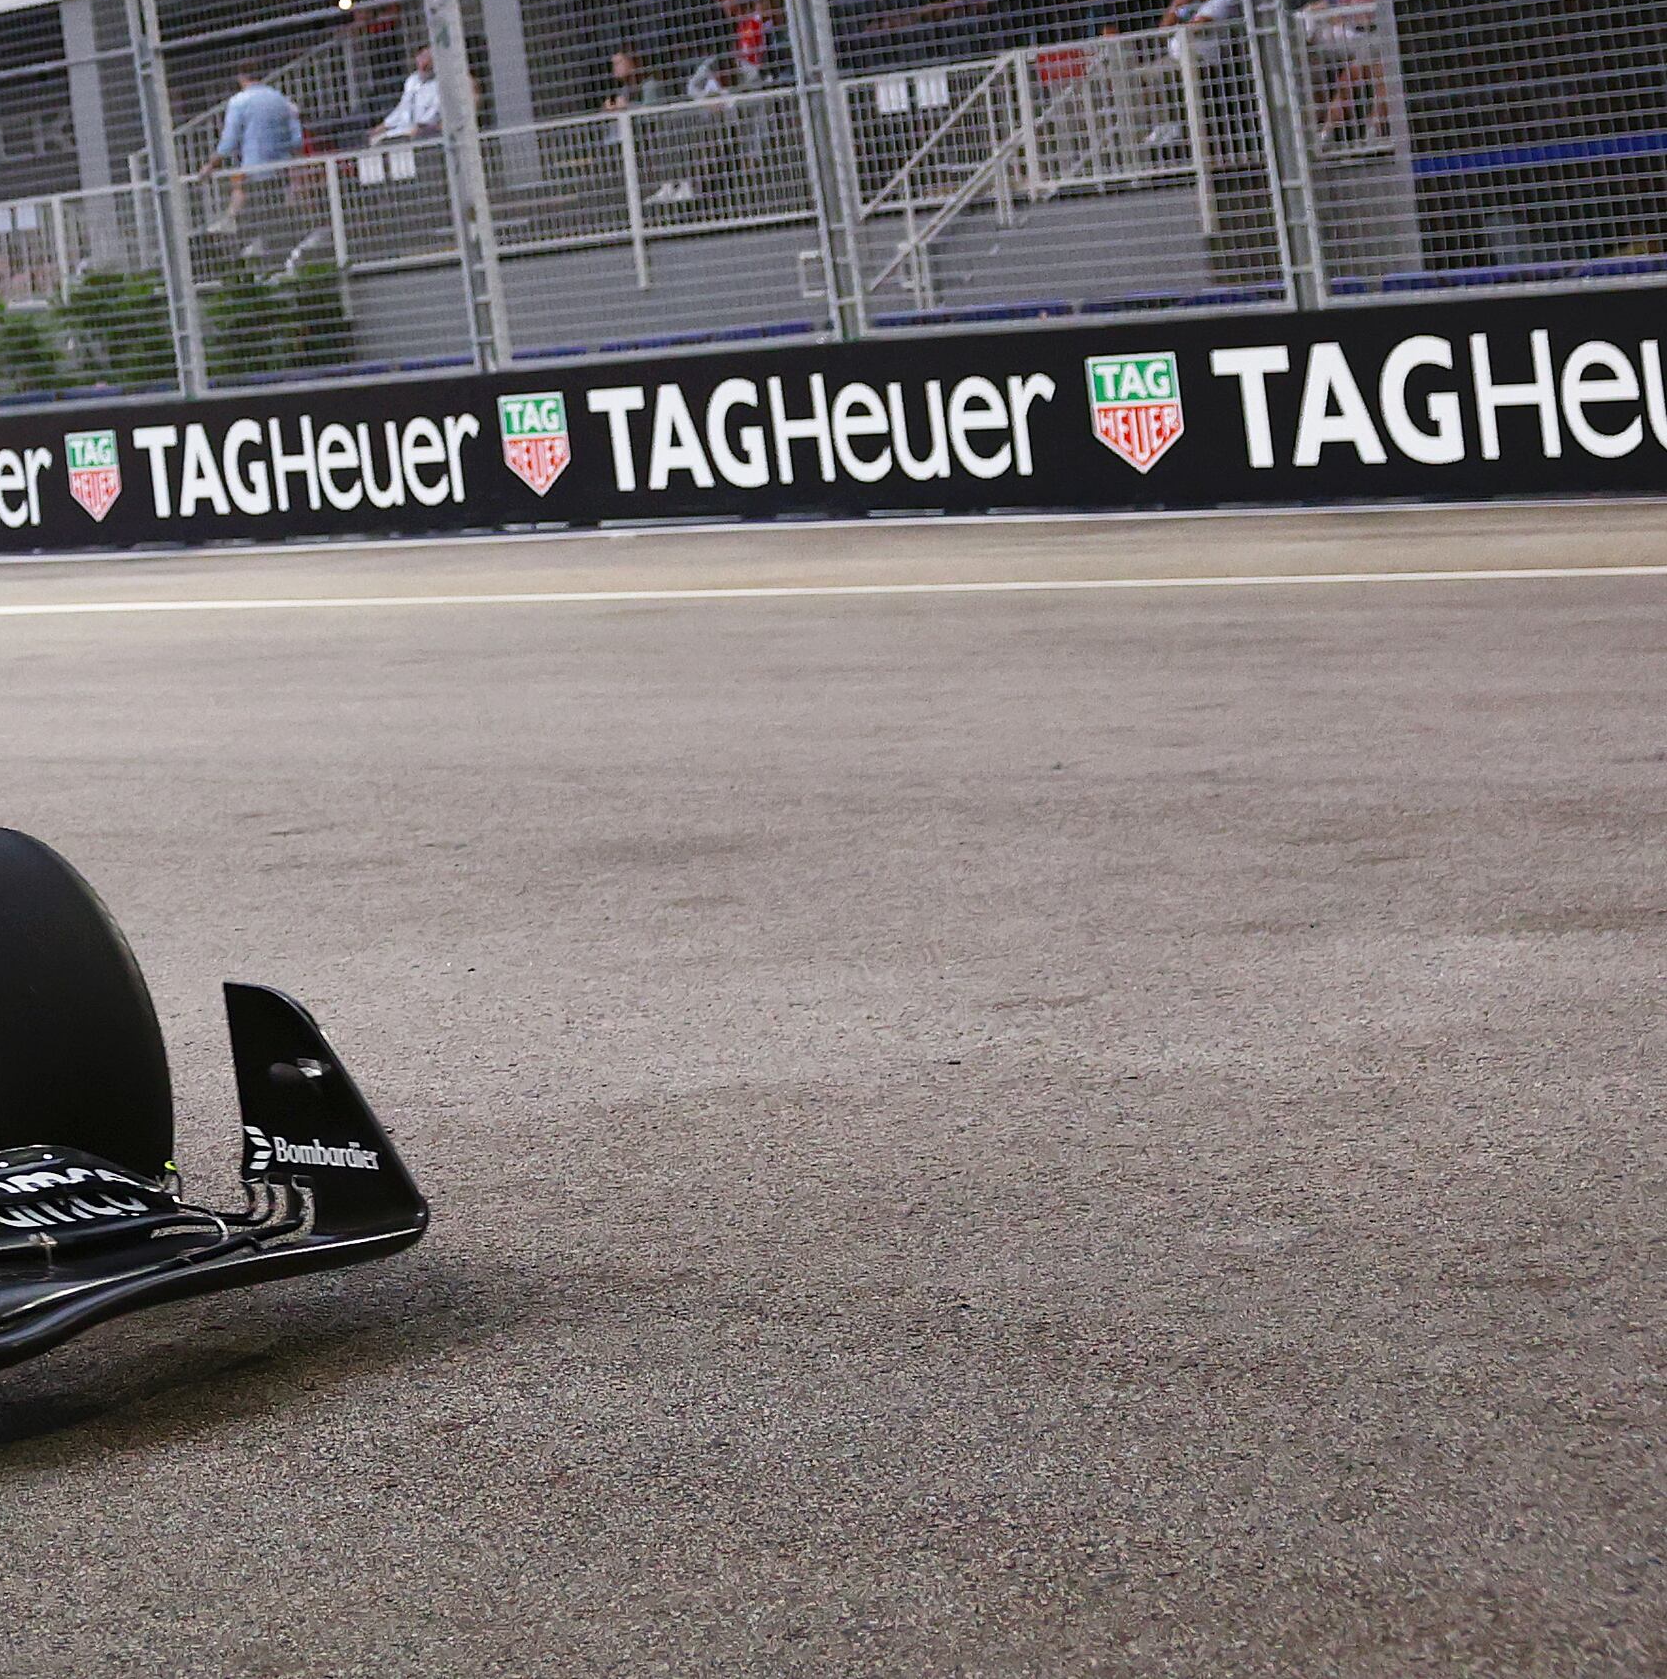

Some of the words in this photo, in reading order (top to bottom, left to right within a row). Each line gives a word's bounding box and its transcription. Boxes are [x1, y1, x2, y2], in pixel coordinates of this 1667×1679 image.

[1092, 359, 1172, 401] TAG
[1208, 328, 1667, 469] TAGHe
[504, 397, 562, 433] TAG
[1098, 404, 1181, 465] HEUER
[68, 436, 114, 466] TAG
[273, 1134, 380, 1172] Bombardier
